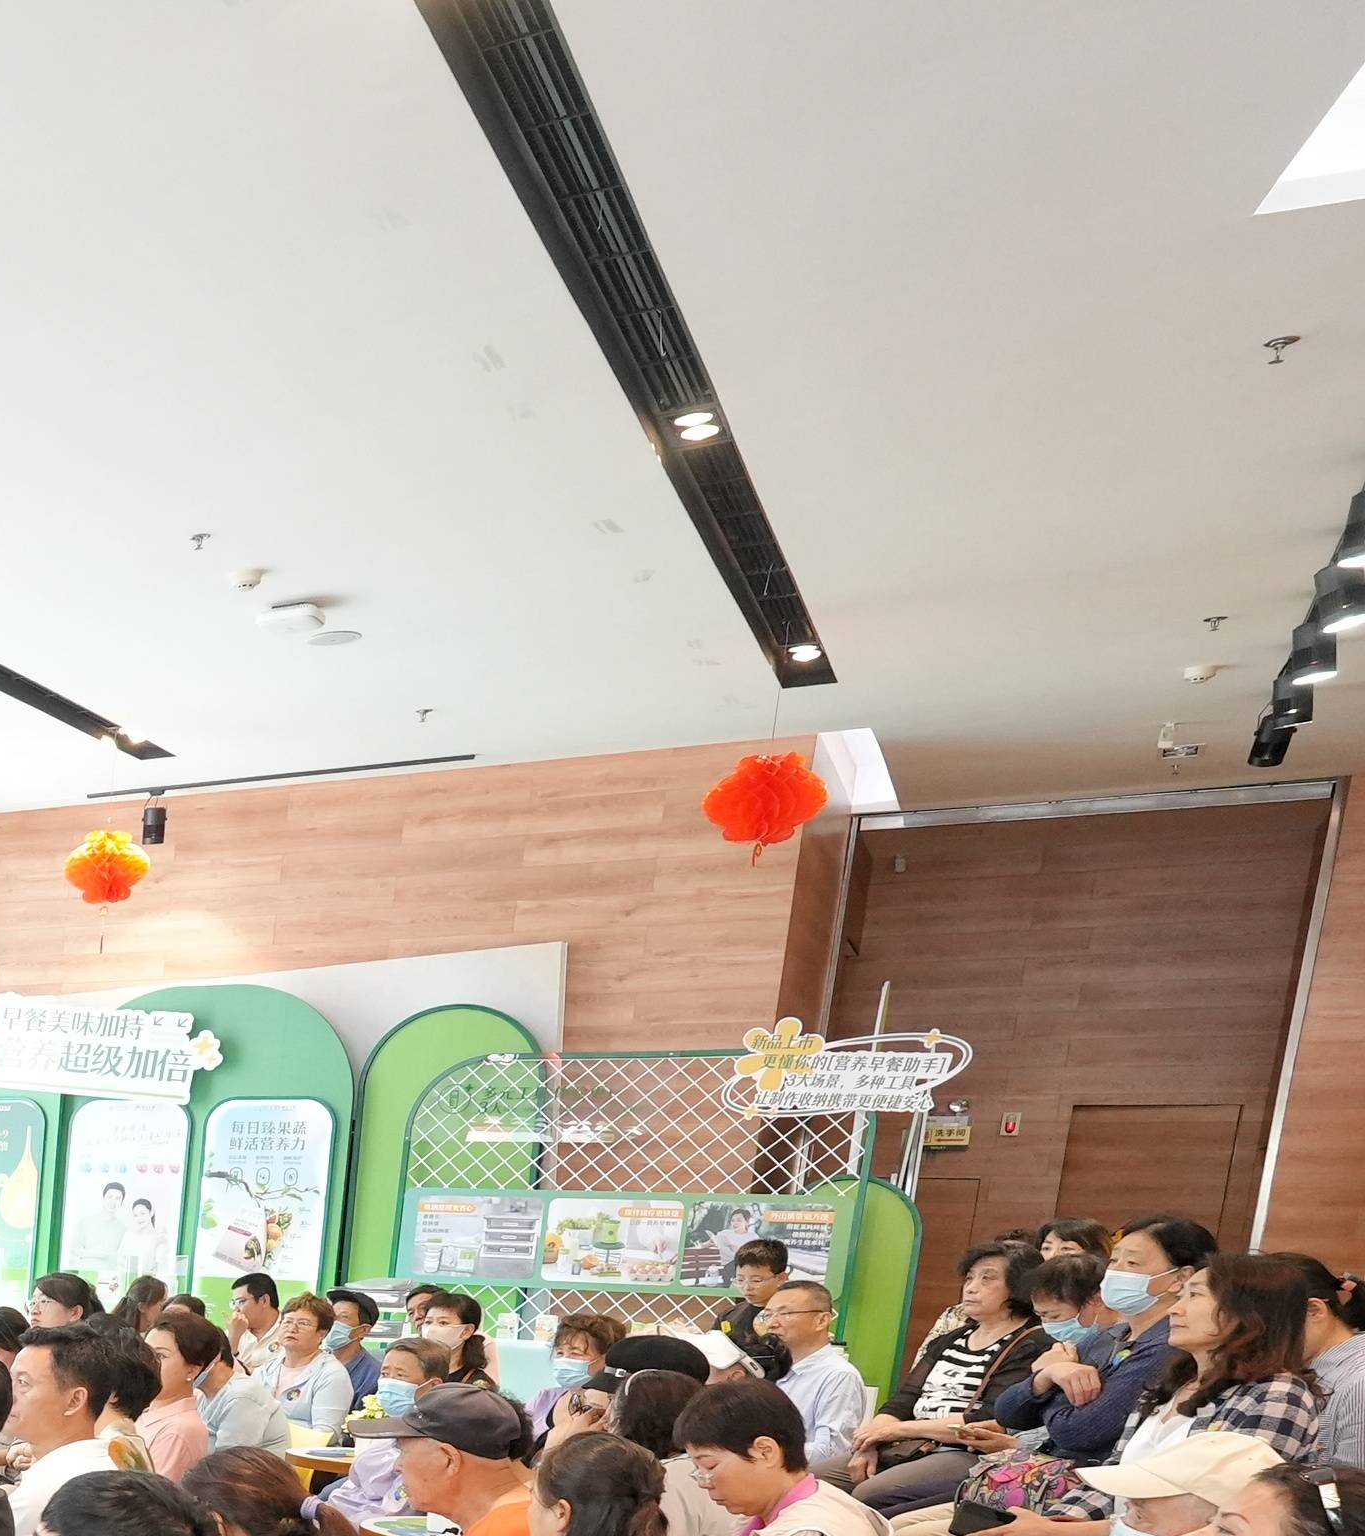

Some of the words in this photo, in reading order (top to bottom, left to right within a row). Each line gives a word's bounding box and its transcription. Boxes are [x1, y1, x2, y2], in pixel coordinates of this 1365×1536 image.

[3, 1007, 144, 1040] 早餐美味加持
[751, 1034, 813, 1050] 新品上市
[755, 1091, 932, 1111] 让制作收纳携带更便捷安心
[934, 1129, 965, 1137] 洗手间
[229, 1137, 305, 1151] 鲜活营养力
